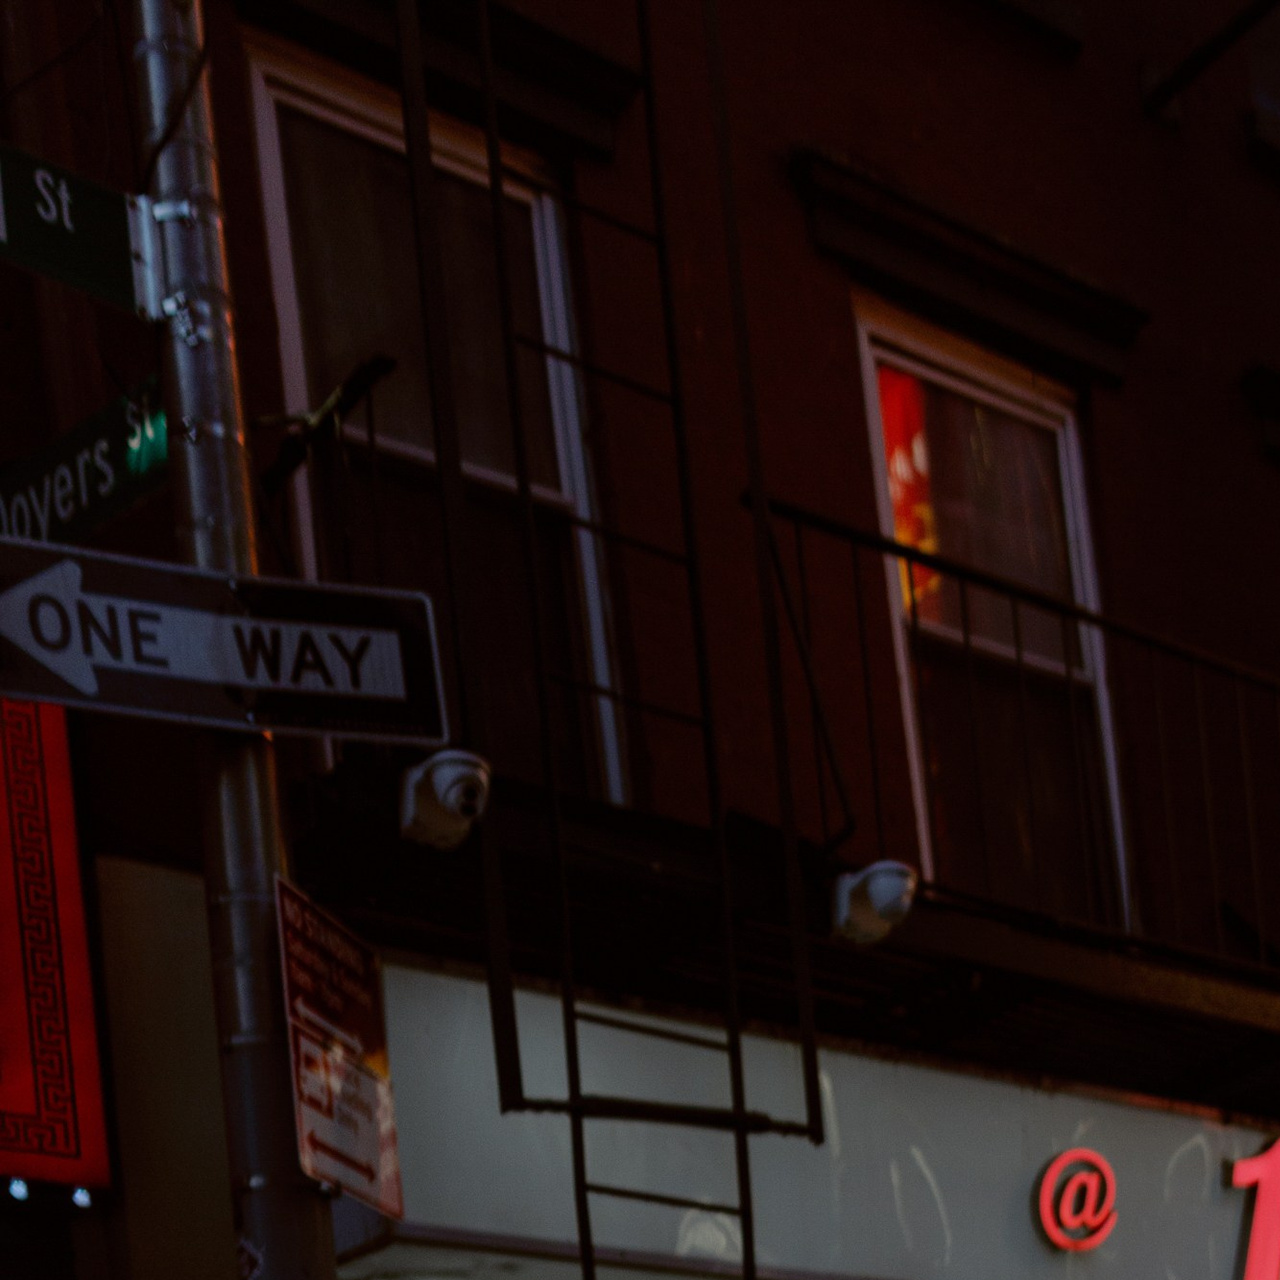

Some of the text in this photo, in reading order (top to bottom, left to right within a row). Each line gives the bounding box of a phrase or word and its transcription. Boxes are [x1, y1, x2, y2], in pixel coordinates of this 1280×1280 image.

[34, 168, 76, 234] St
[0, 434, 116, 541] oyers
[28, 594, 371, 690] ONE WAY
[1039, 1147, 1118, 1252] @
